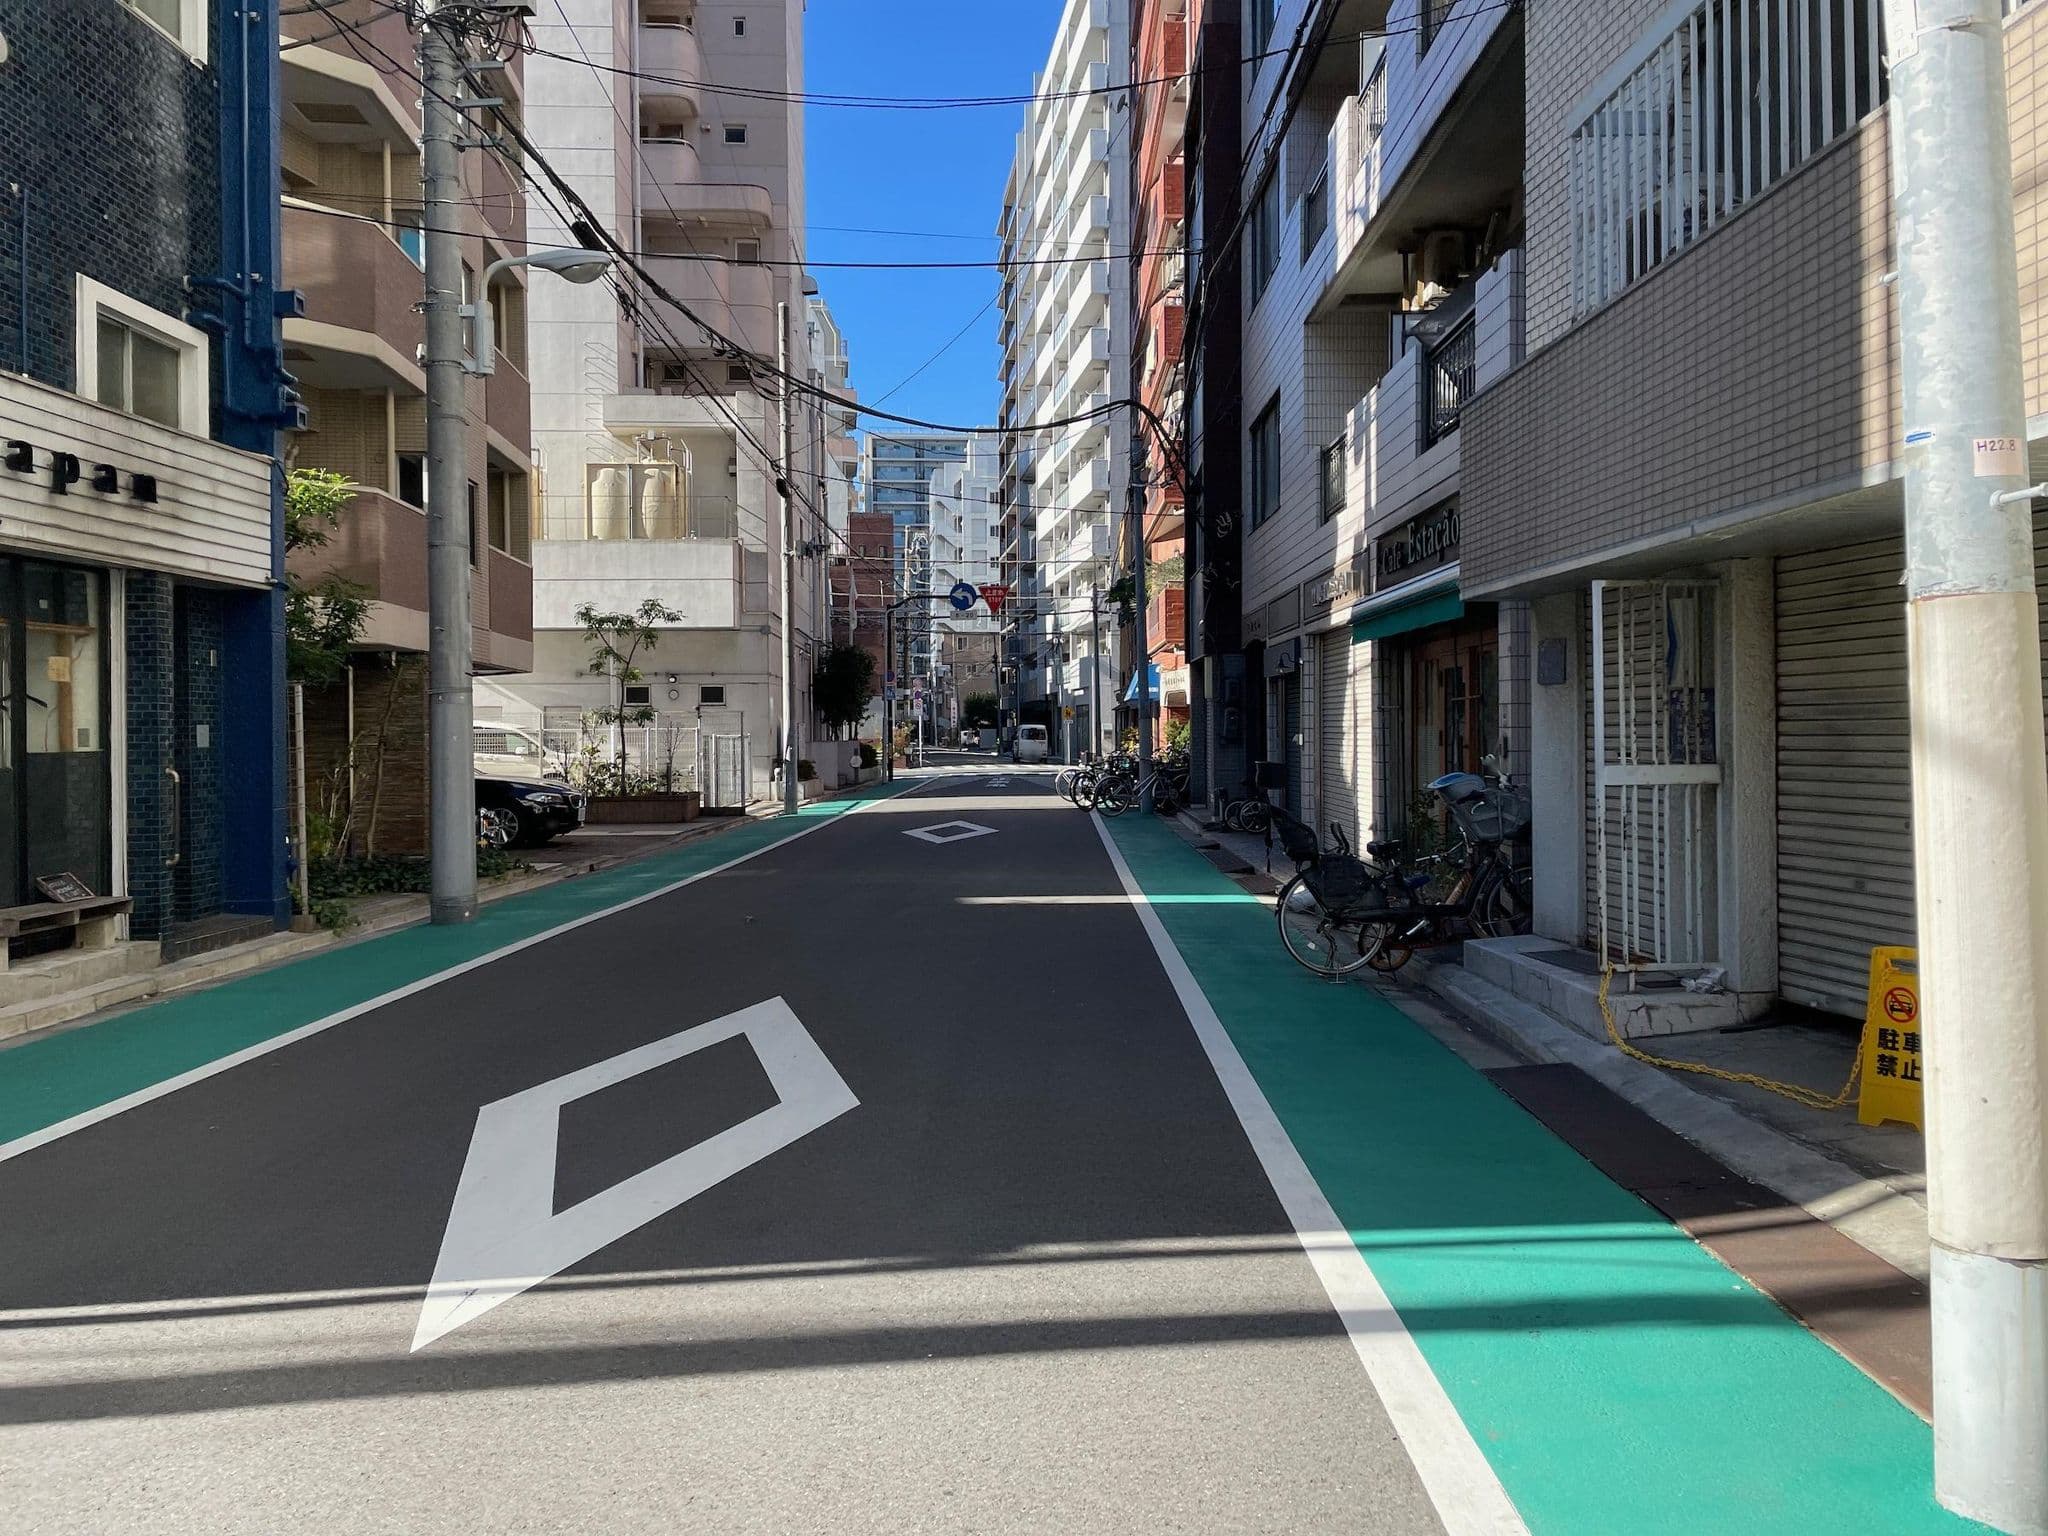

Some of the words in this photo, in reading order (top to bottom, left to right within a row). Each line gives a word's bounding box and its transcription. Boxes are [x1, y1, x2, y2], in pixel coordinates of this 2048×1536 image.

[1976, 439, 2016, 452] H22.8
[1407, 509, 1459, 564] Estação
[1877, 1027, 1921, 1054] 駐車
[1876, 1053, 1921, 1082] 禁止
